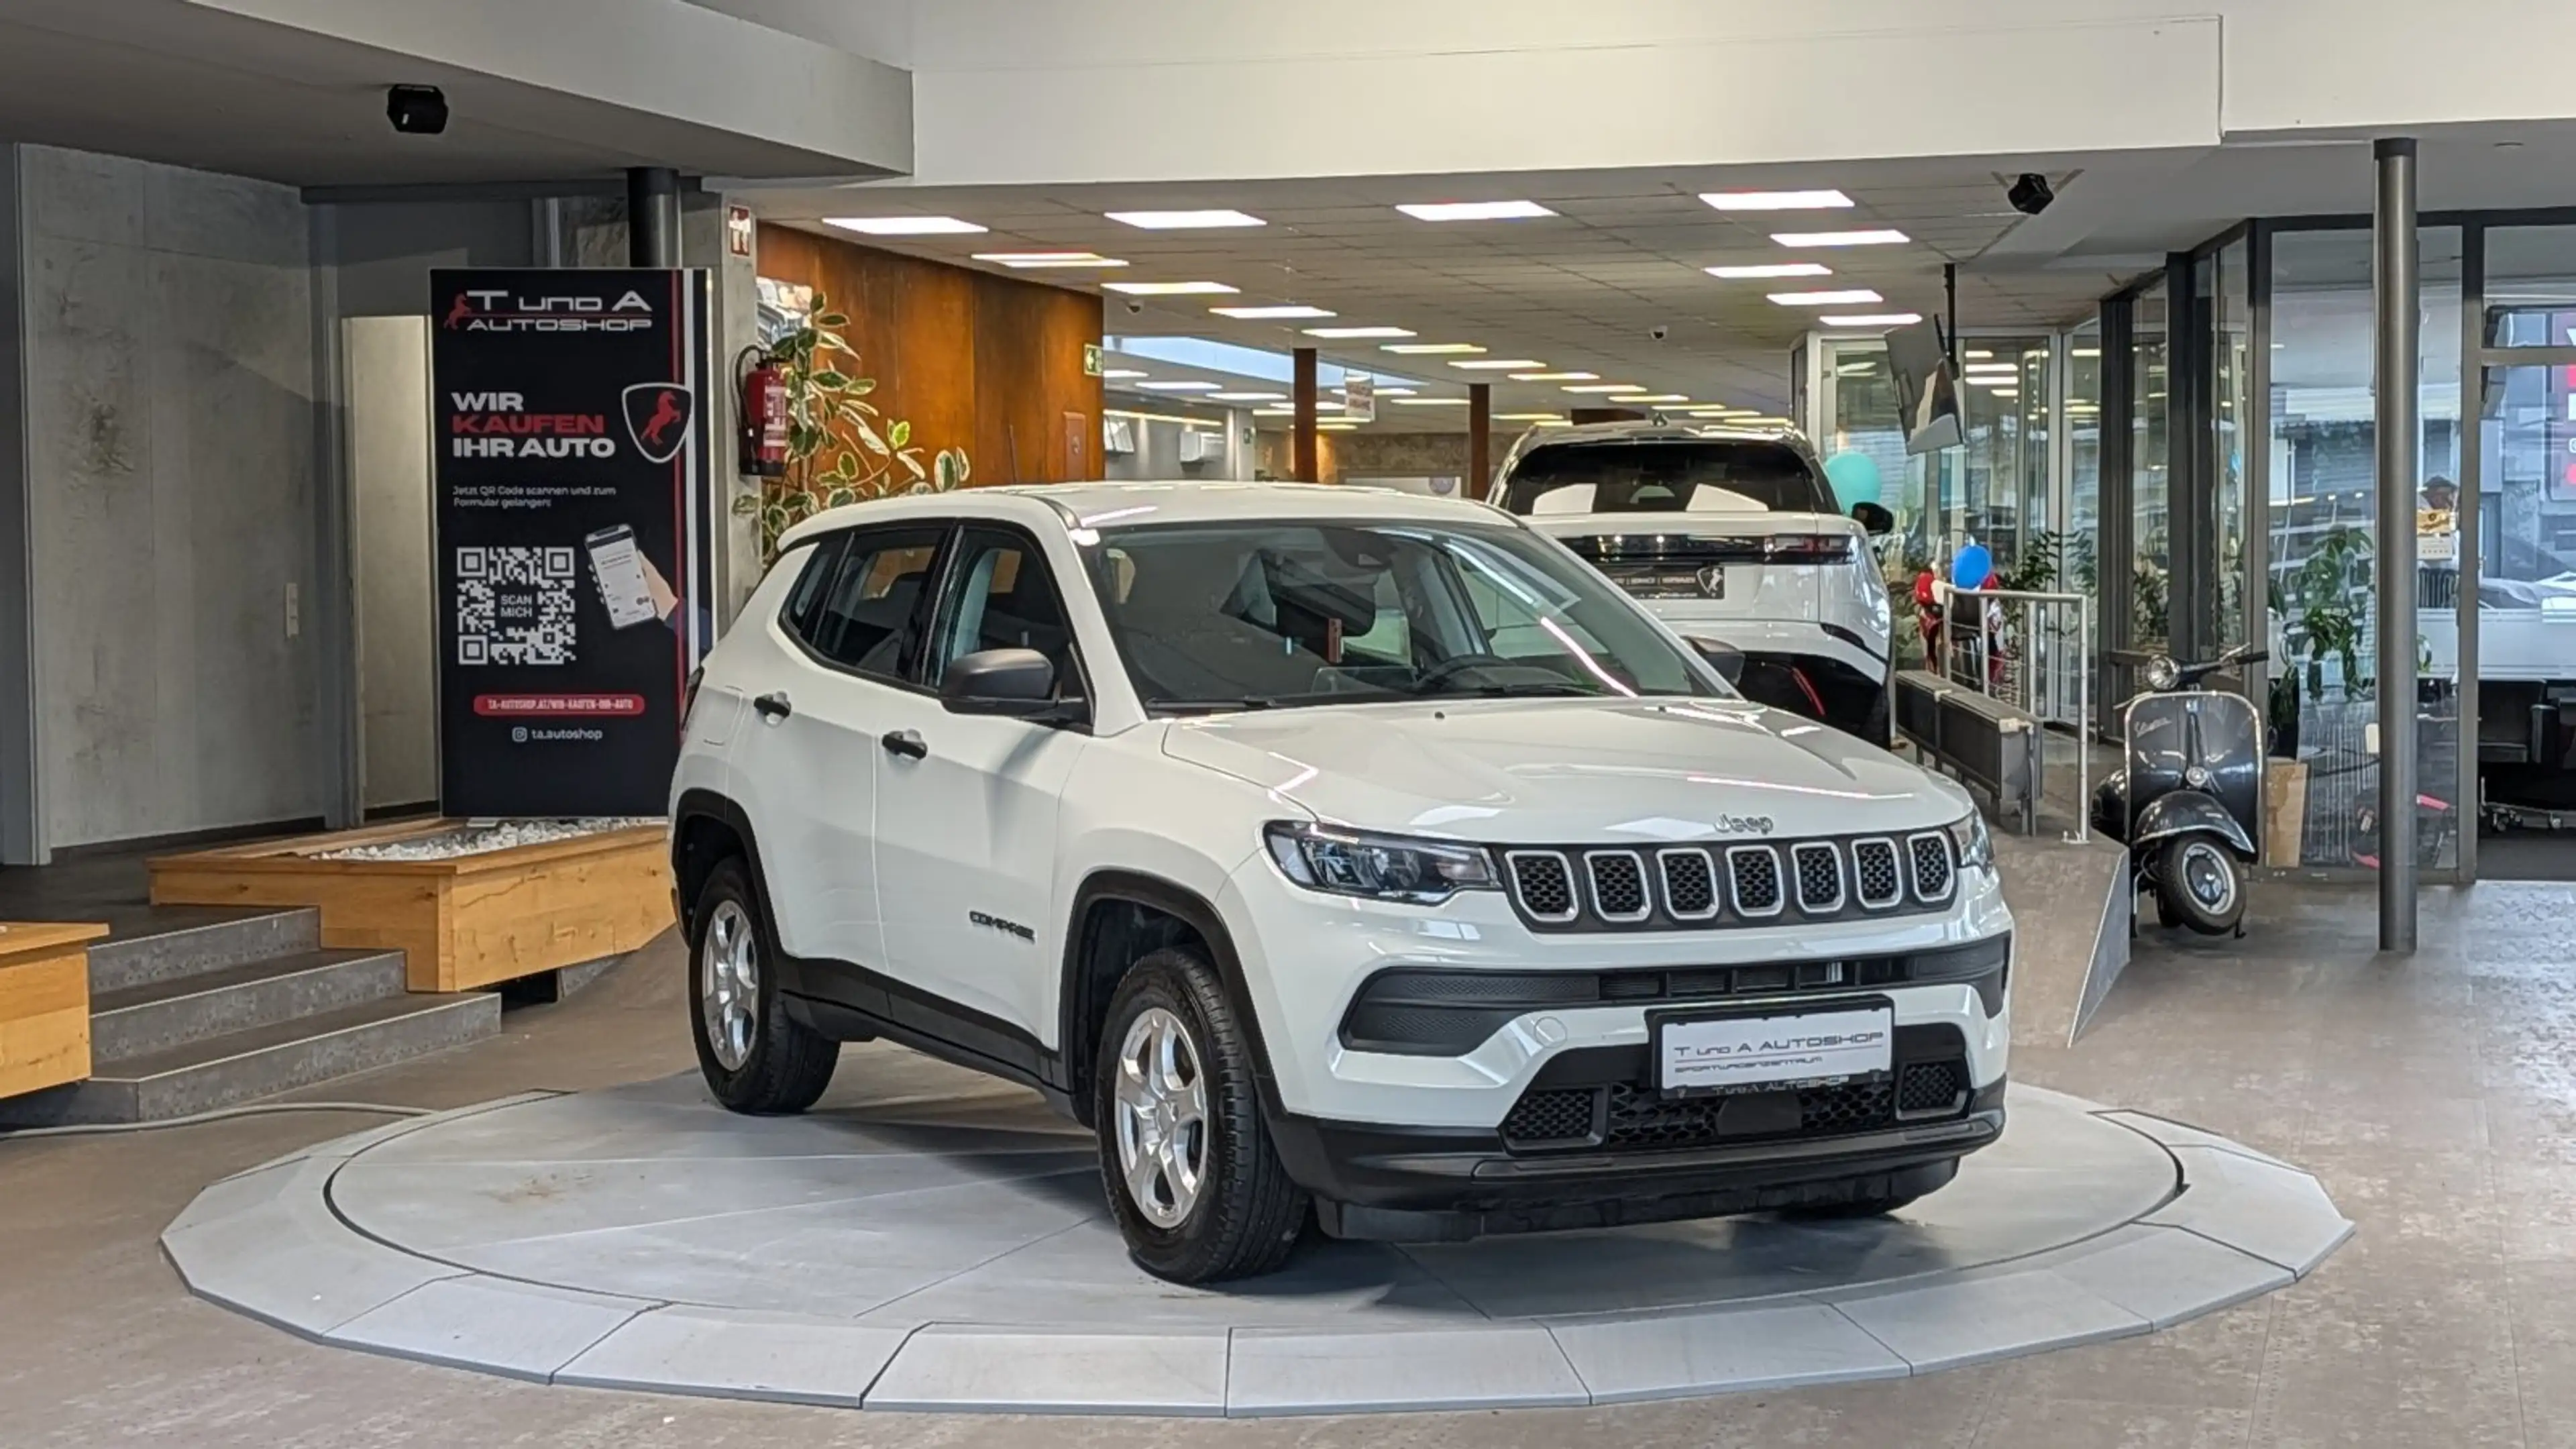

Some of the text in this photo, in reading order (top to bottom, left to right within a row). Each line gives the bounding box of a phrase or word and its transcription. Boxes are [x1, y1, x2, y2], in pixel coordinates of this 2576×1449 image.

[466, 290, 508, 311] T
[611, 290, 653, 312] A
[466, 318, 653, 331] AUTOSHOP
[451, 392, 525, 412] WIR
[452, 414, 605, 434] KAUFEN
[452, 437, 616, 458] IHR AUTO
[453, 486, 616, 496] Jetzt QR Code scannen und zum
[453, 497, 499, 507] Formular
[500, 594, 532, 605] SCAN
[500, 606, 533, 618] MICH
[531, 727, 603, 741] ta.autoshop
[1714, 813, 1774, 836] Jeep
[1674, 1046, 1690, 1056] T
[1737, 1042, 1752, 1053] A
[1758, 1031, 1884, 1051] AUTOSHOP
